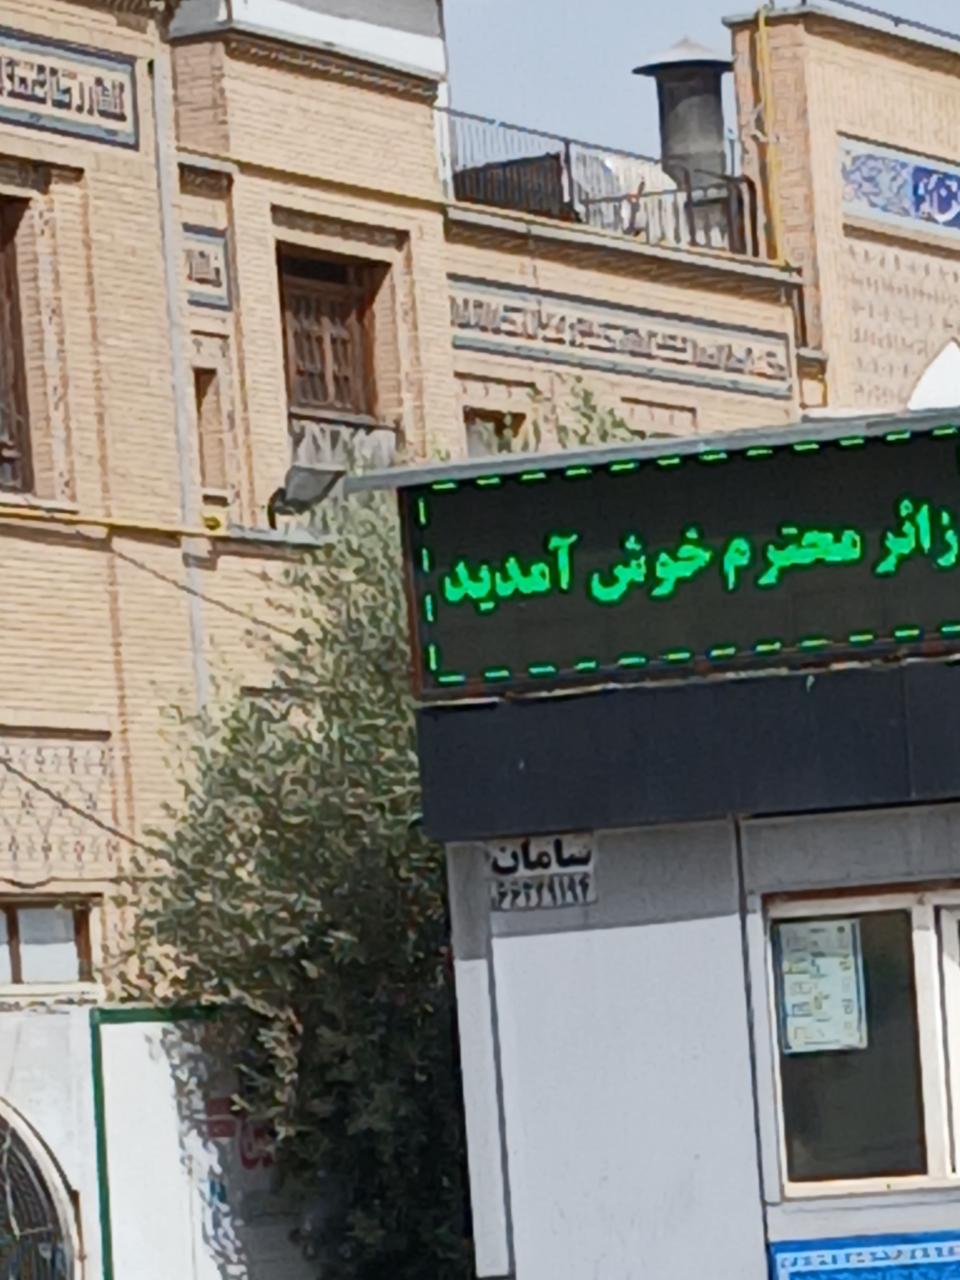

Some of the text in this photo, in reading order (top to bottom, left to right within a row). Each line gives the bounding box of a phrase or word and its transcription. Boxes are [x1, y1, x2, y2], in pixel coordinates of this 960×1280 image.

[443, 533, 579, 612] آمدید
[590, 527, 713, 602] خوش
[723, 526, 862, 591] محترم
[874, 498, 959, 574] زائر
[491, 836, 593, 875] سامان
